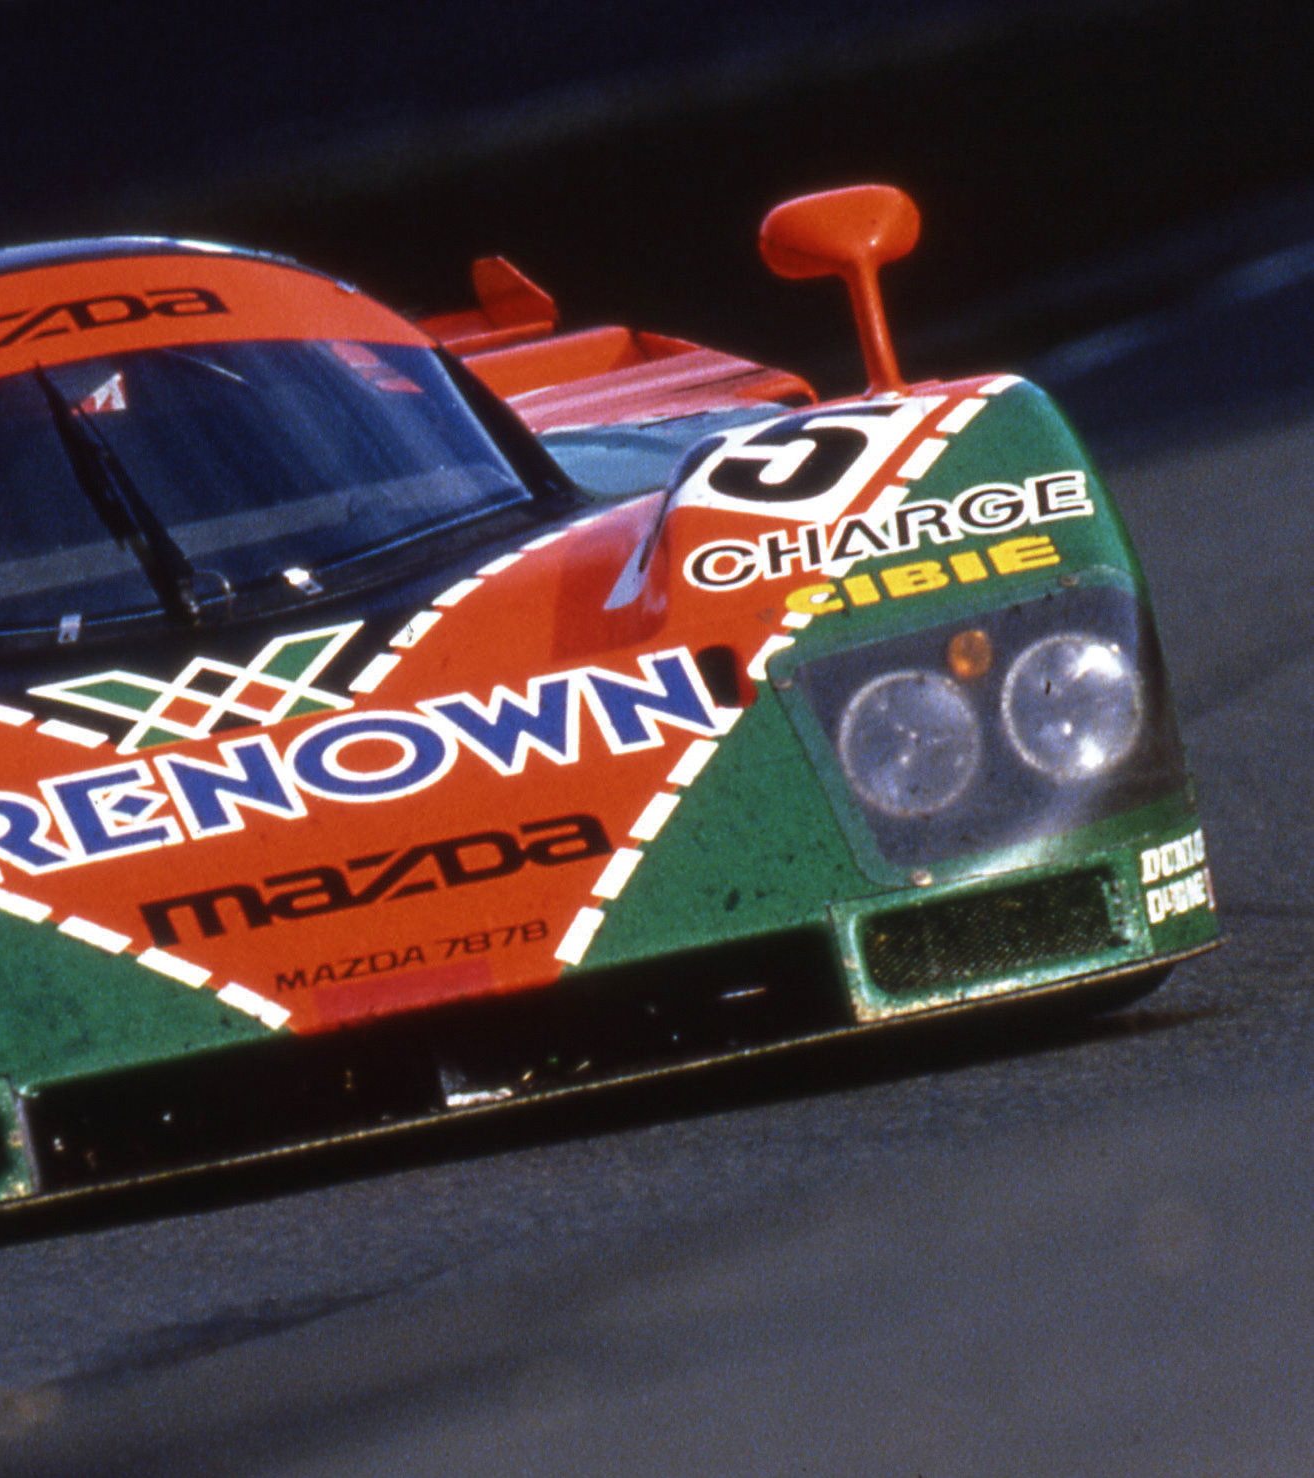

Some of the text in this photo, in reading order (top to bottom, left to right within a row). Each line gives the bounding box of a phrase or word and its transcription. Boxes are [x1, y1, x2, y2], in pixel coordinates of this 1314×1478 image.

[708, 403, 906, 502] 5
[683, 470, 1094, 592] CHARGE
[785, 536, 1061, 616] CIBIE
[274, 945, 427, 994] MAZDA
